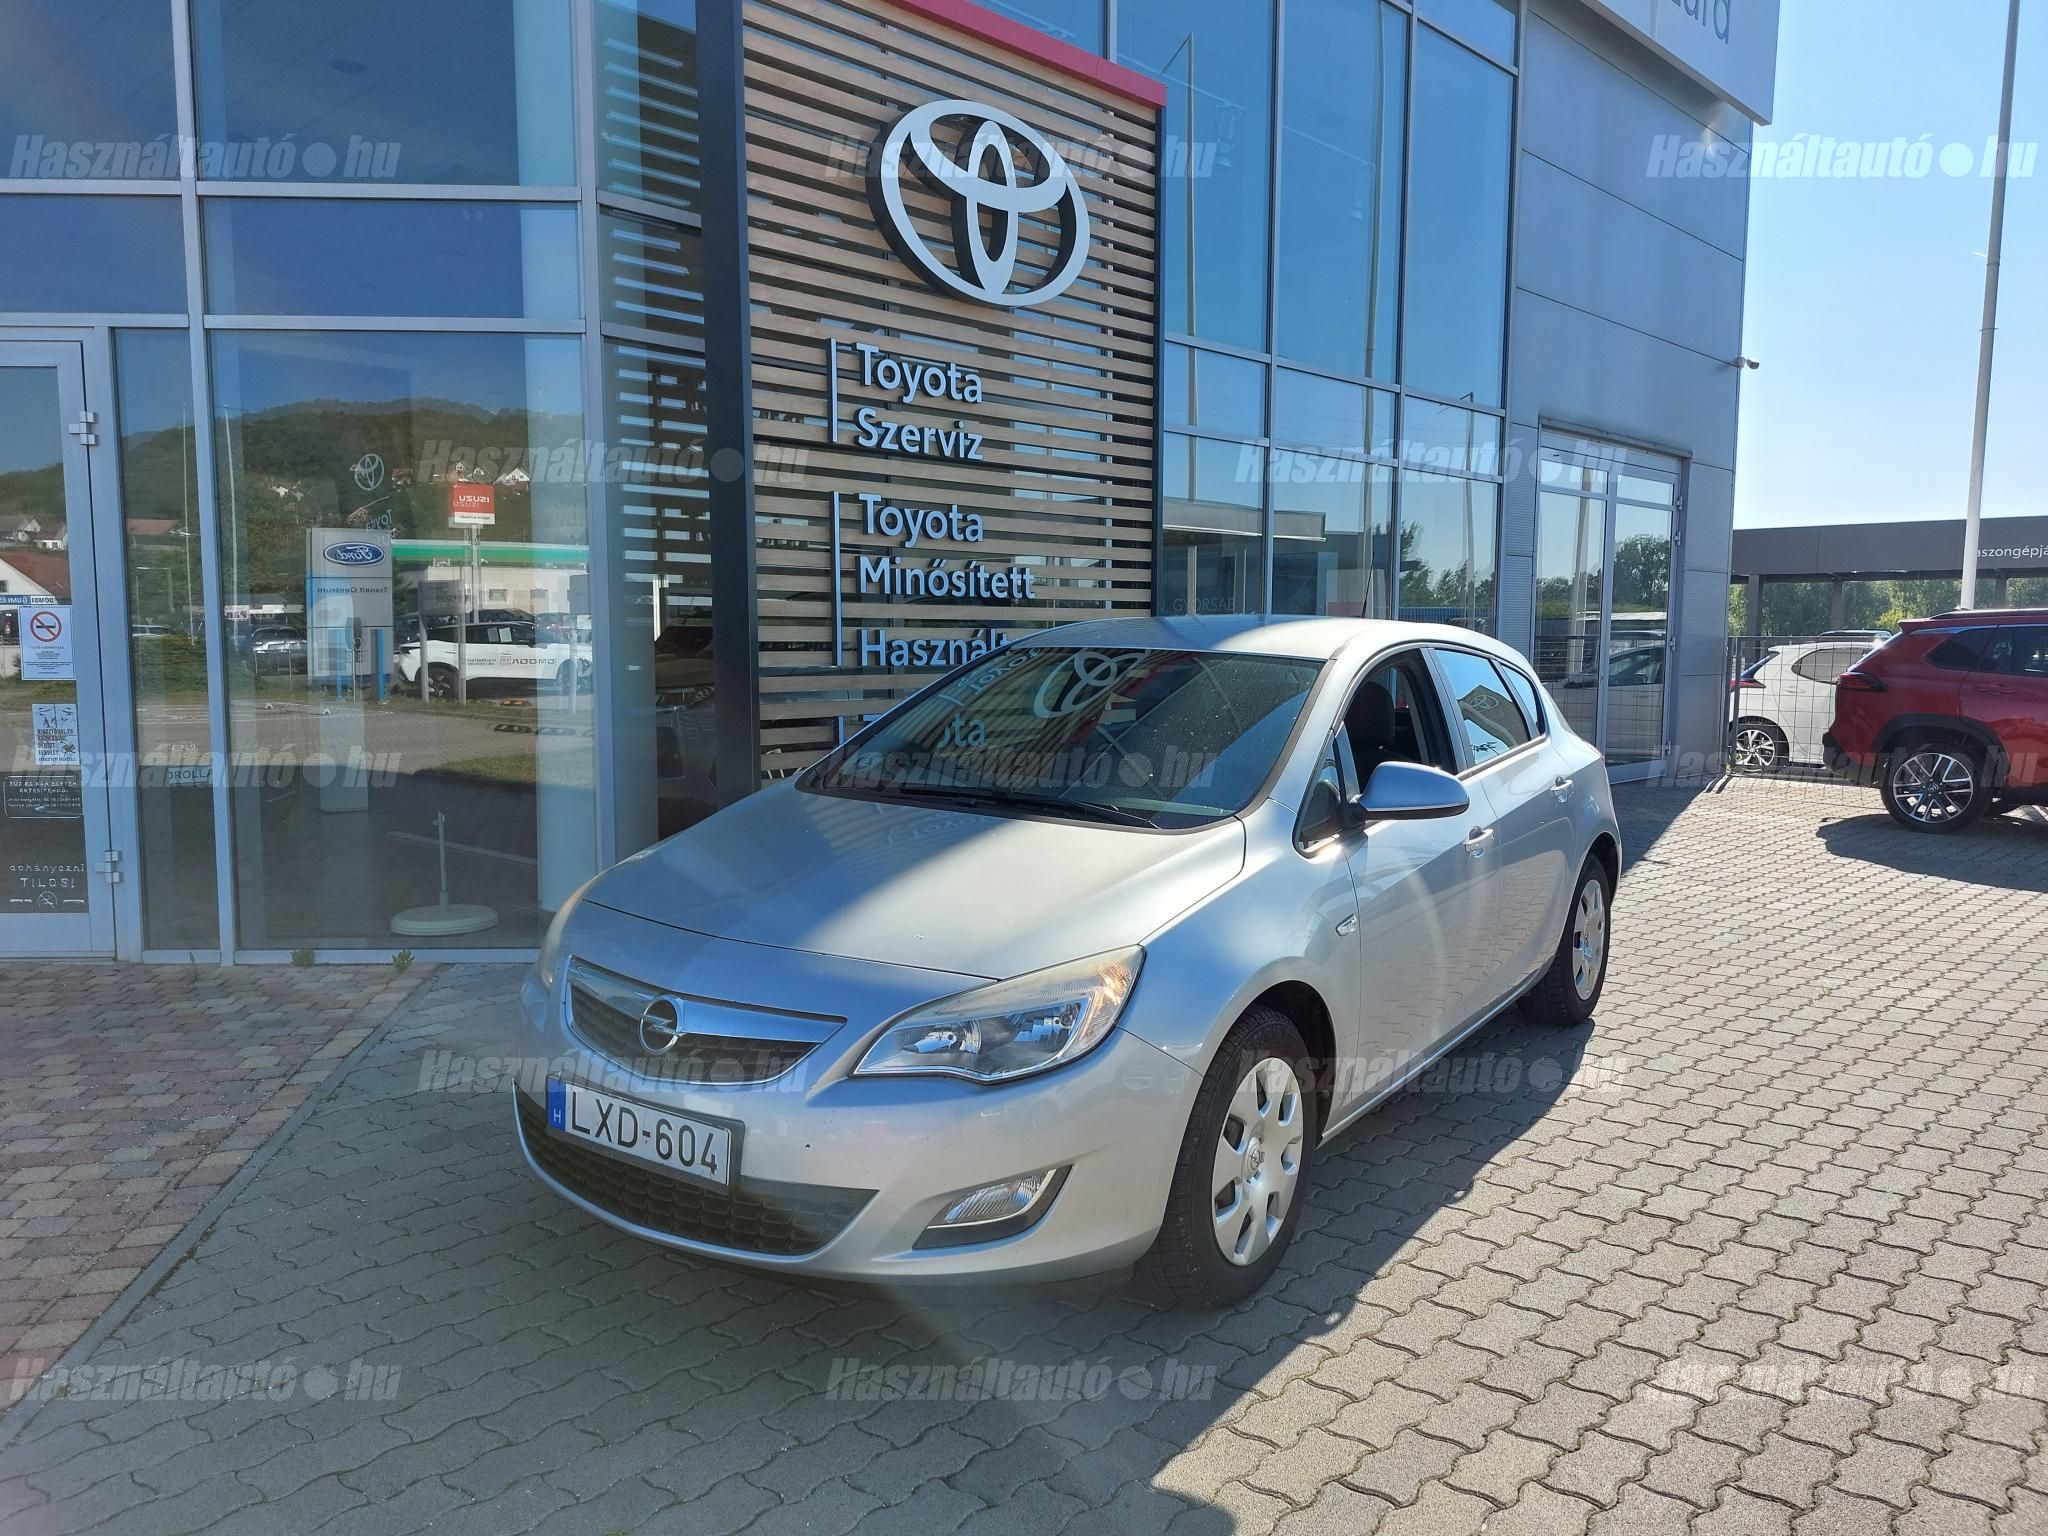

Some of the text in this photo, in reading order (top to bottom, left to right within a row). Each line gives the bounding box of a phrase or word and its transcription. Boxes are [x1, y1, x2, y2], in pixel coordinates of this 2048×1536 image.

[855, 342, 983, 403] Toyota
[855, 406, 984, 461] Szerviz
[858, 492, 985, 548] Toyota
[857, 554, 1036, 600] Minősített
[553, 1108, 562, 1124] H
[571, 1091, 718, 1176] LXD-604
